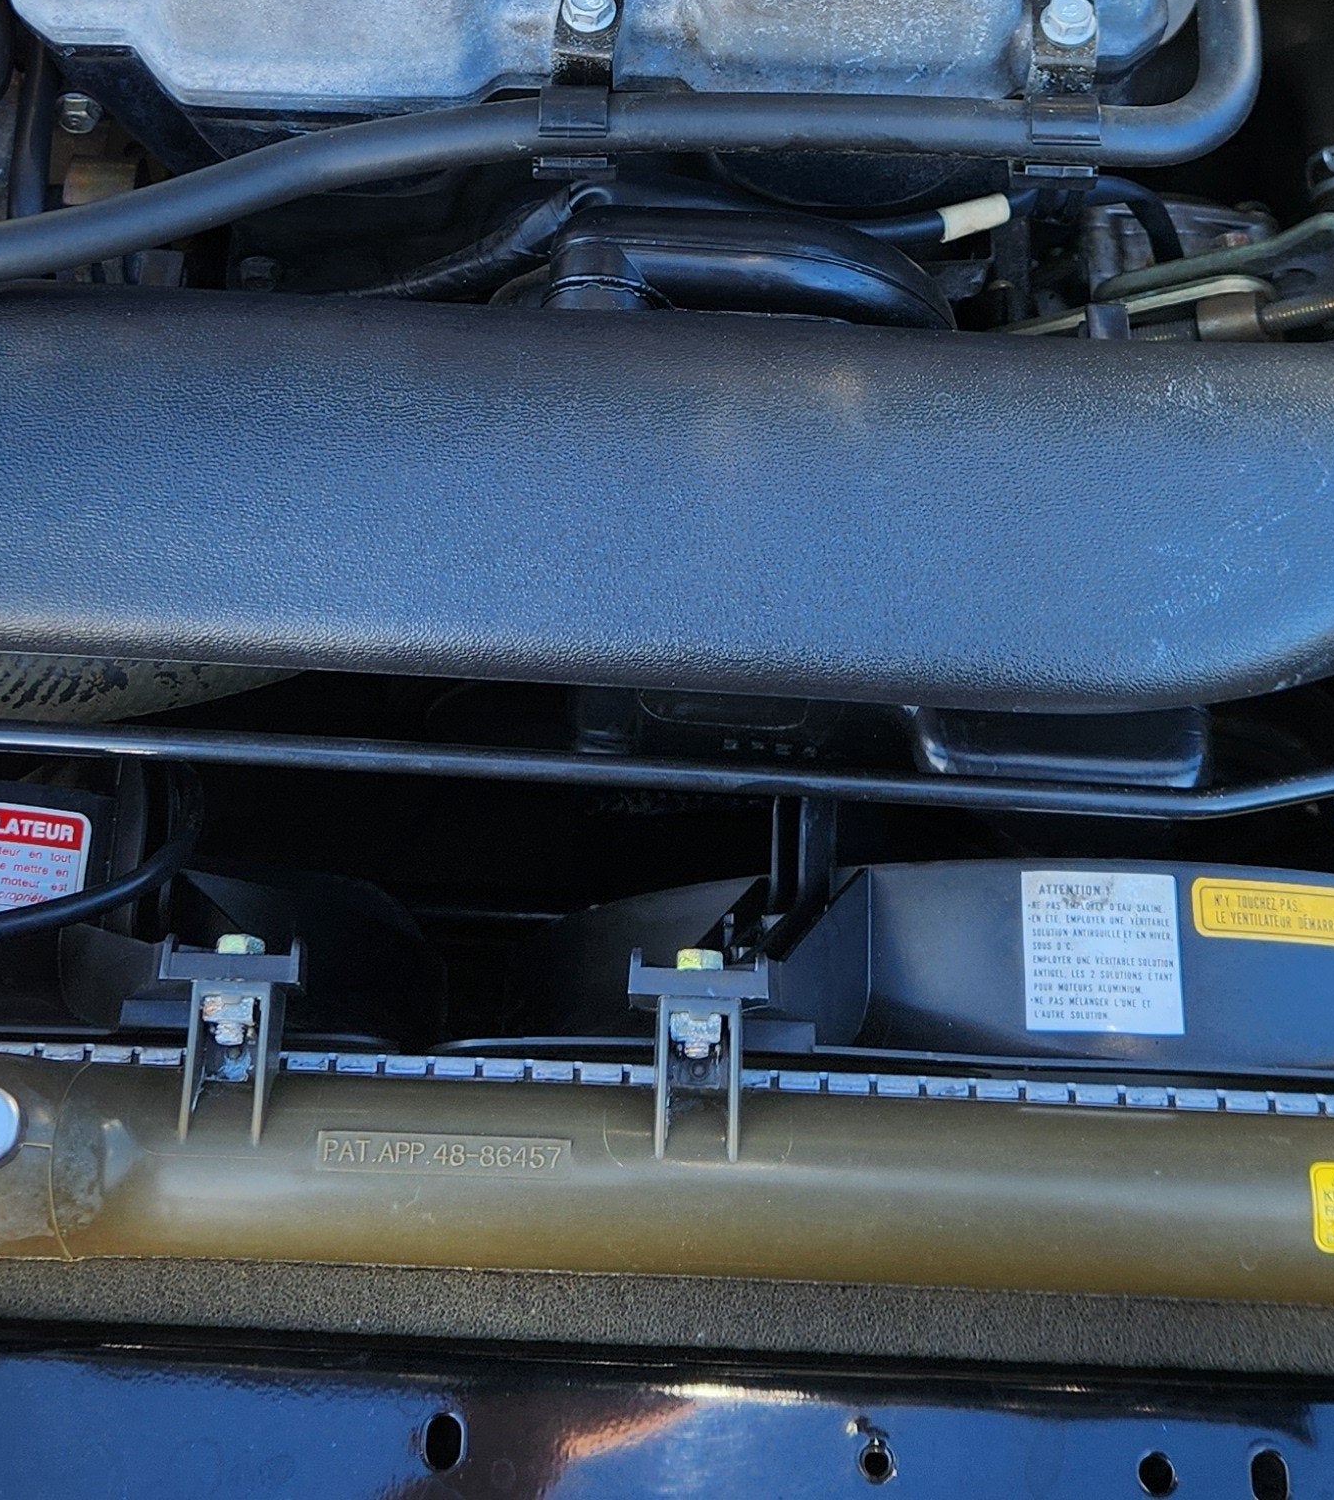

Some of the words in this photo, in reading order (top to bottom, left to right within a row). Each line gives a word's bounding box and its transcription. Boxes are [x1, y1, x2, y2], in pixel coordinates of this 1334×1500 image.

[29, 851, 42, 859] en
[50, 852, 72, 864] tout
[14, 863, 49, 875] mettre
[55, 869, 69, 878] en
[1, 876, 40, 888] moteur
[1039, 884, 1101, 895] ATTENTION
[1047, 901, 1061, 909] PAS
[1237, 895, 1278, 911] TOUCHEZ
[1067, 915, 1105, 924] EMPLOYER
[1110, 916, 1124, 925] UNE
[1216, 911, 1227, 924] LE
[1231, 911, 1292, 928] VENTILATEUR
[1033, 928, 1067, 937] SOLUTION
[1073, 929, 1123, 938] ANTIROUILLE
[1137, 932, 1146, 940] EN
[1033, 942, 1052, 950] SOUS
[1033, 955, 1071, 964] EMPLOYER
[1077, 956, 1091, 964] UNE
[1138, 958, 1174, 968] SOLUTION
[1071, 970, 1085, 978] LES
[1091, 970, 1095, 978] 2
[1101, 970, 1143, 980] SOLUTIONS
[1034, 982, 1053, 991] POUR
[1058, 983, 1093, 992] MOTEURS
[1049, 996, 1063, 1005] PAS
[1142, 999, 1151, 1008] ET
